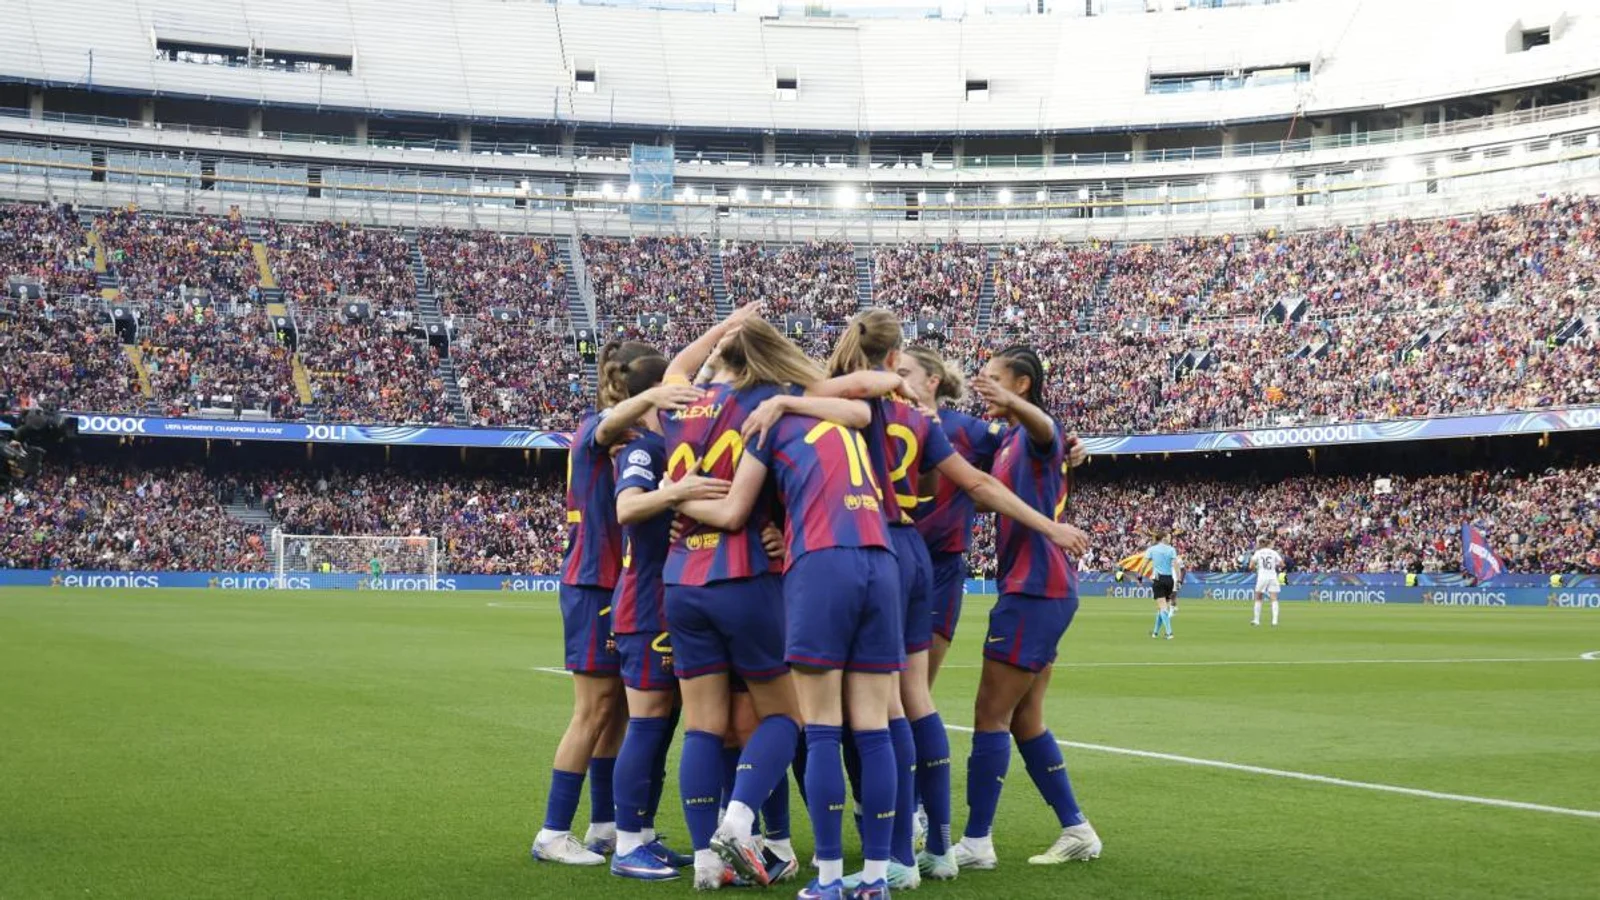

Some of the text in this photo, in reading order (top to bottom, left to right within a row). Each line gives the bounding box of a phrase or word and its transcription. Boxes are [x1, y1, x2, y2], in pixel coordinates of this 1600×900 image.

[1569, 408, 1600, 428] GO
[215, 425, 256, 433] CHAMPIONS
[257, 427, 283, 435] LEAGUE
[1260, 555, 1272, 570] 16
[64, 571, 159, 588] euronics
[221, 573, 311, 589] euronics
[370, 574, 456, 591] euronics
[1320, 586, 1386, 604] euronics
[1433, 588, 1506, 606] euronics
